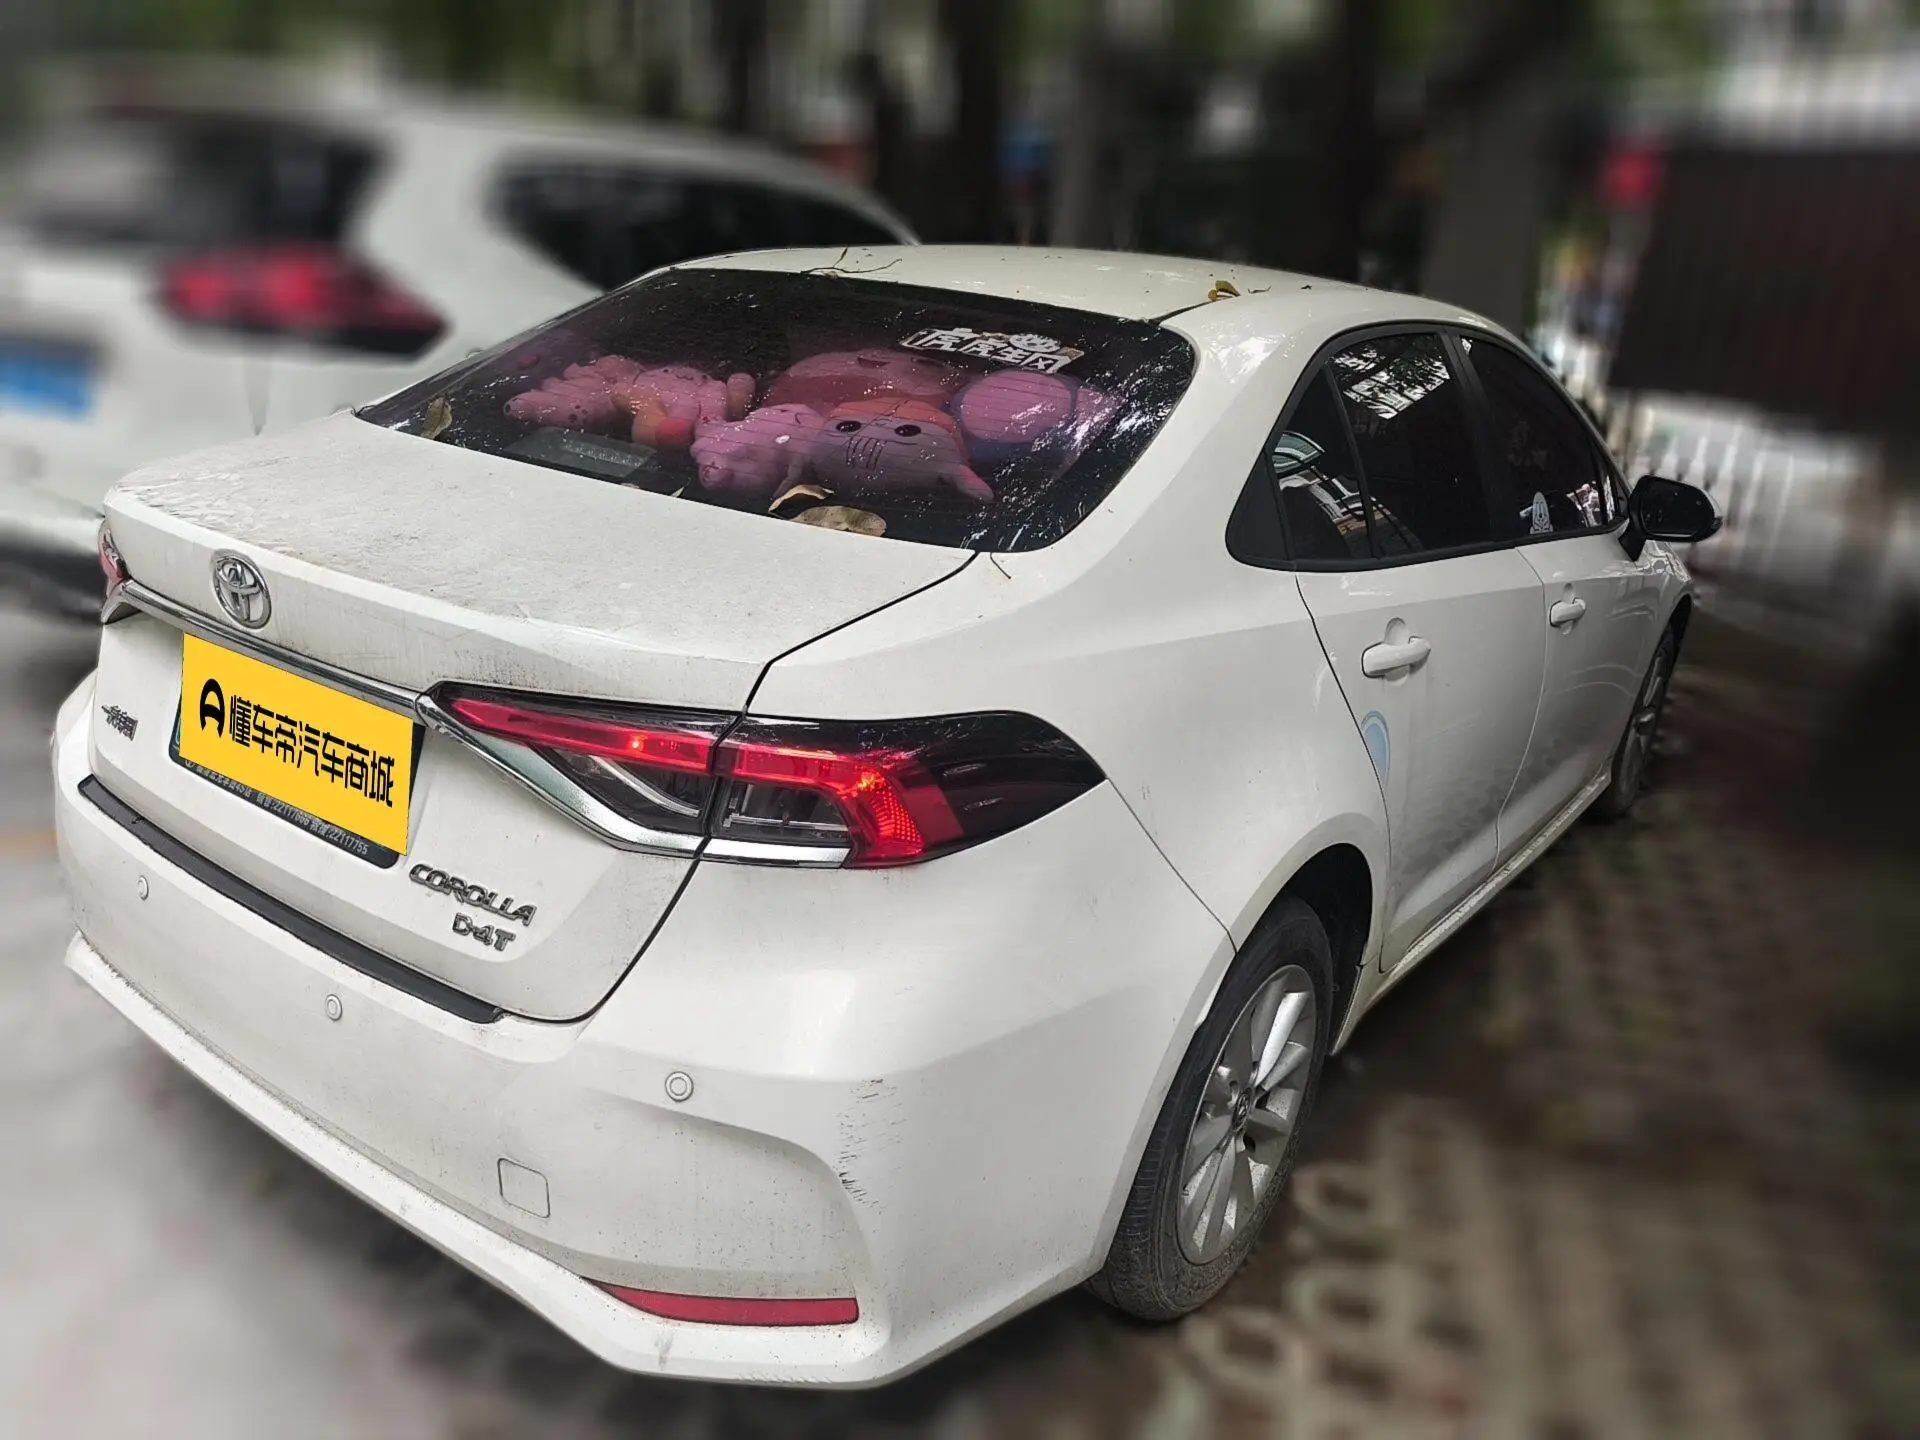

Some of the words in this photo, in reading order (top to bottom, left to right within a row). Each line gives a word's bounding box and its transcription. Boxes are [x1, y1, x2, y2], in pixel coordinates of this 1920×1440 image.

[915, 327, 1072, 374] 虎虎生风
[409, 863, 538, 927] COROLLA
[452, 911, 517, 952] D-4T
